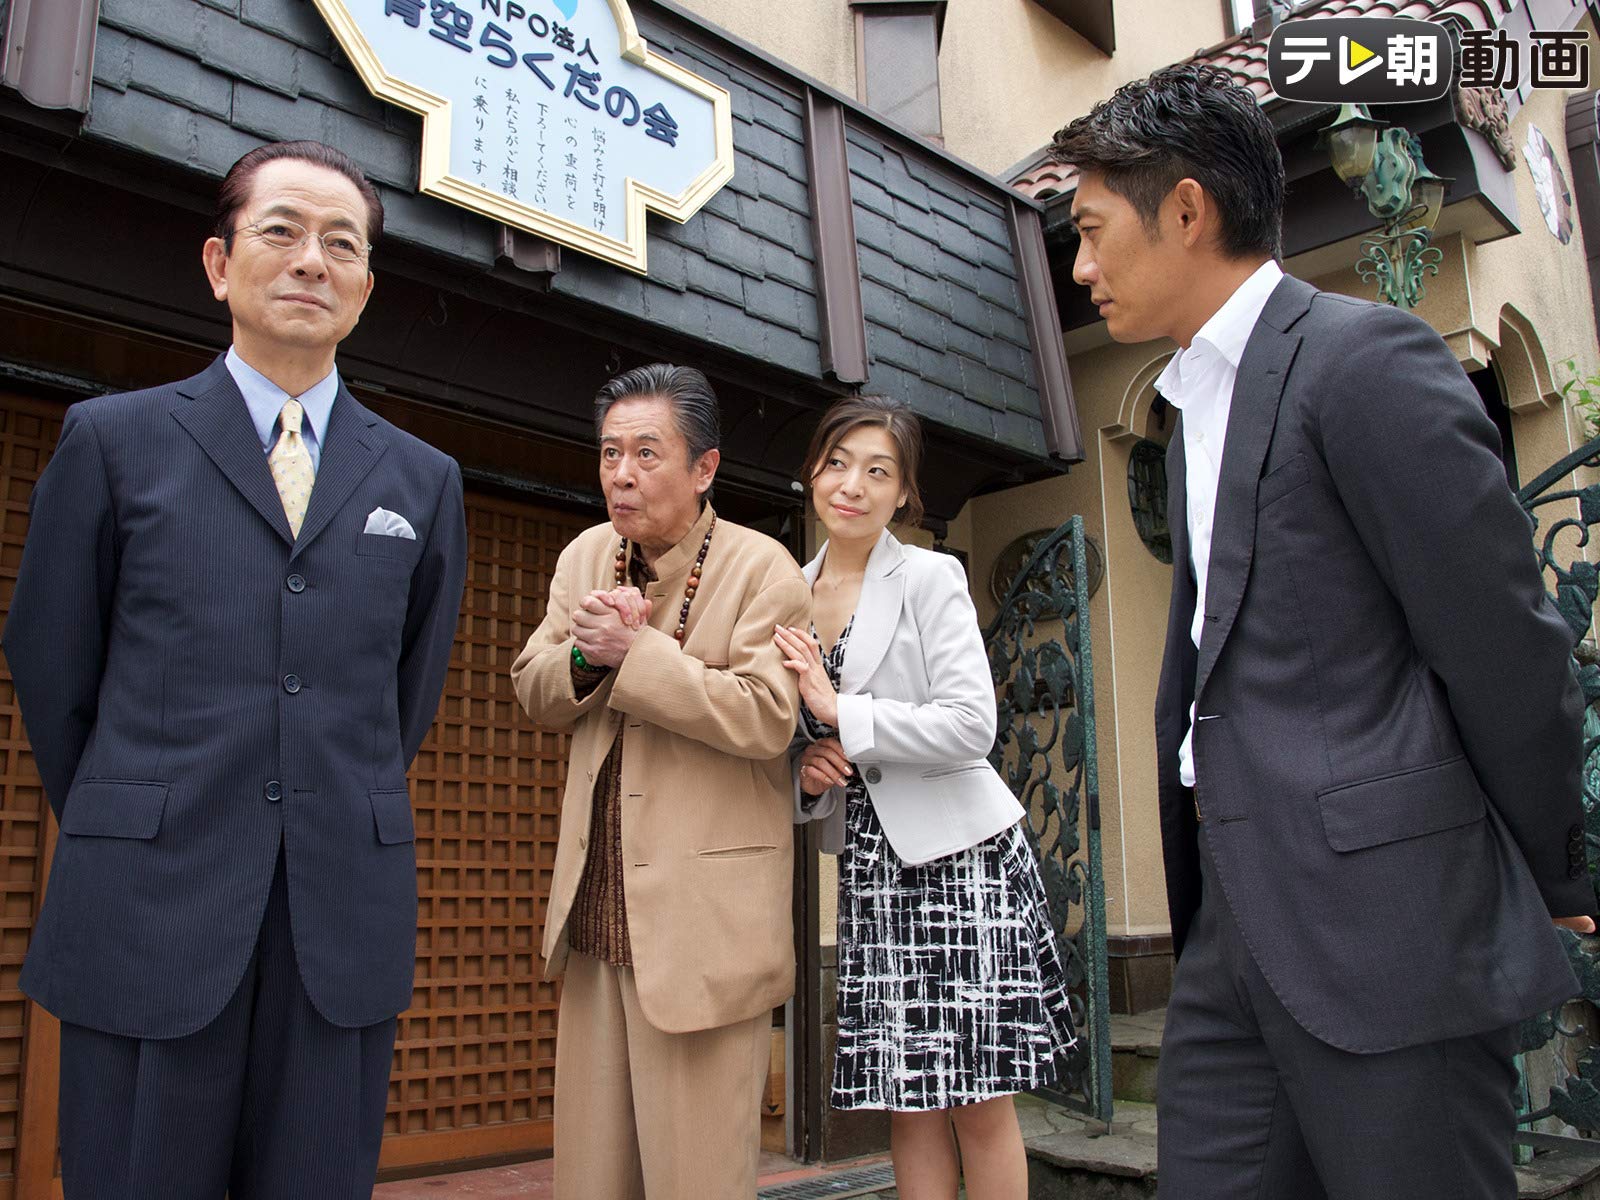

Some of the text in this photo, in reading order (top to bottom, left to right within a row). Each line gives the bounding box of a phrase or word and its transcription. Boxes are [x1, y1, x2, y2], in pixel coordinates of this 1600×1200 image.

[482, 0, 599, 65] NPO法人
[471, 75, 490, 189] に乗ります。
[501, 87, 521, 201] 私たちがご相談
[564, 116, 578, 210] 心の重荷を
[591, 127, 607, 232] 悩みを打ち明け
